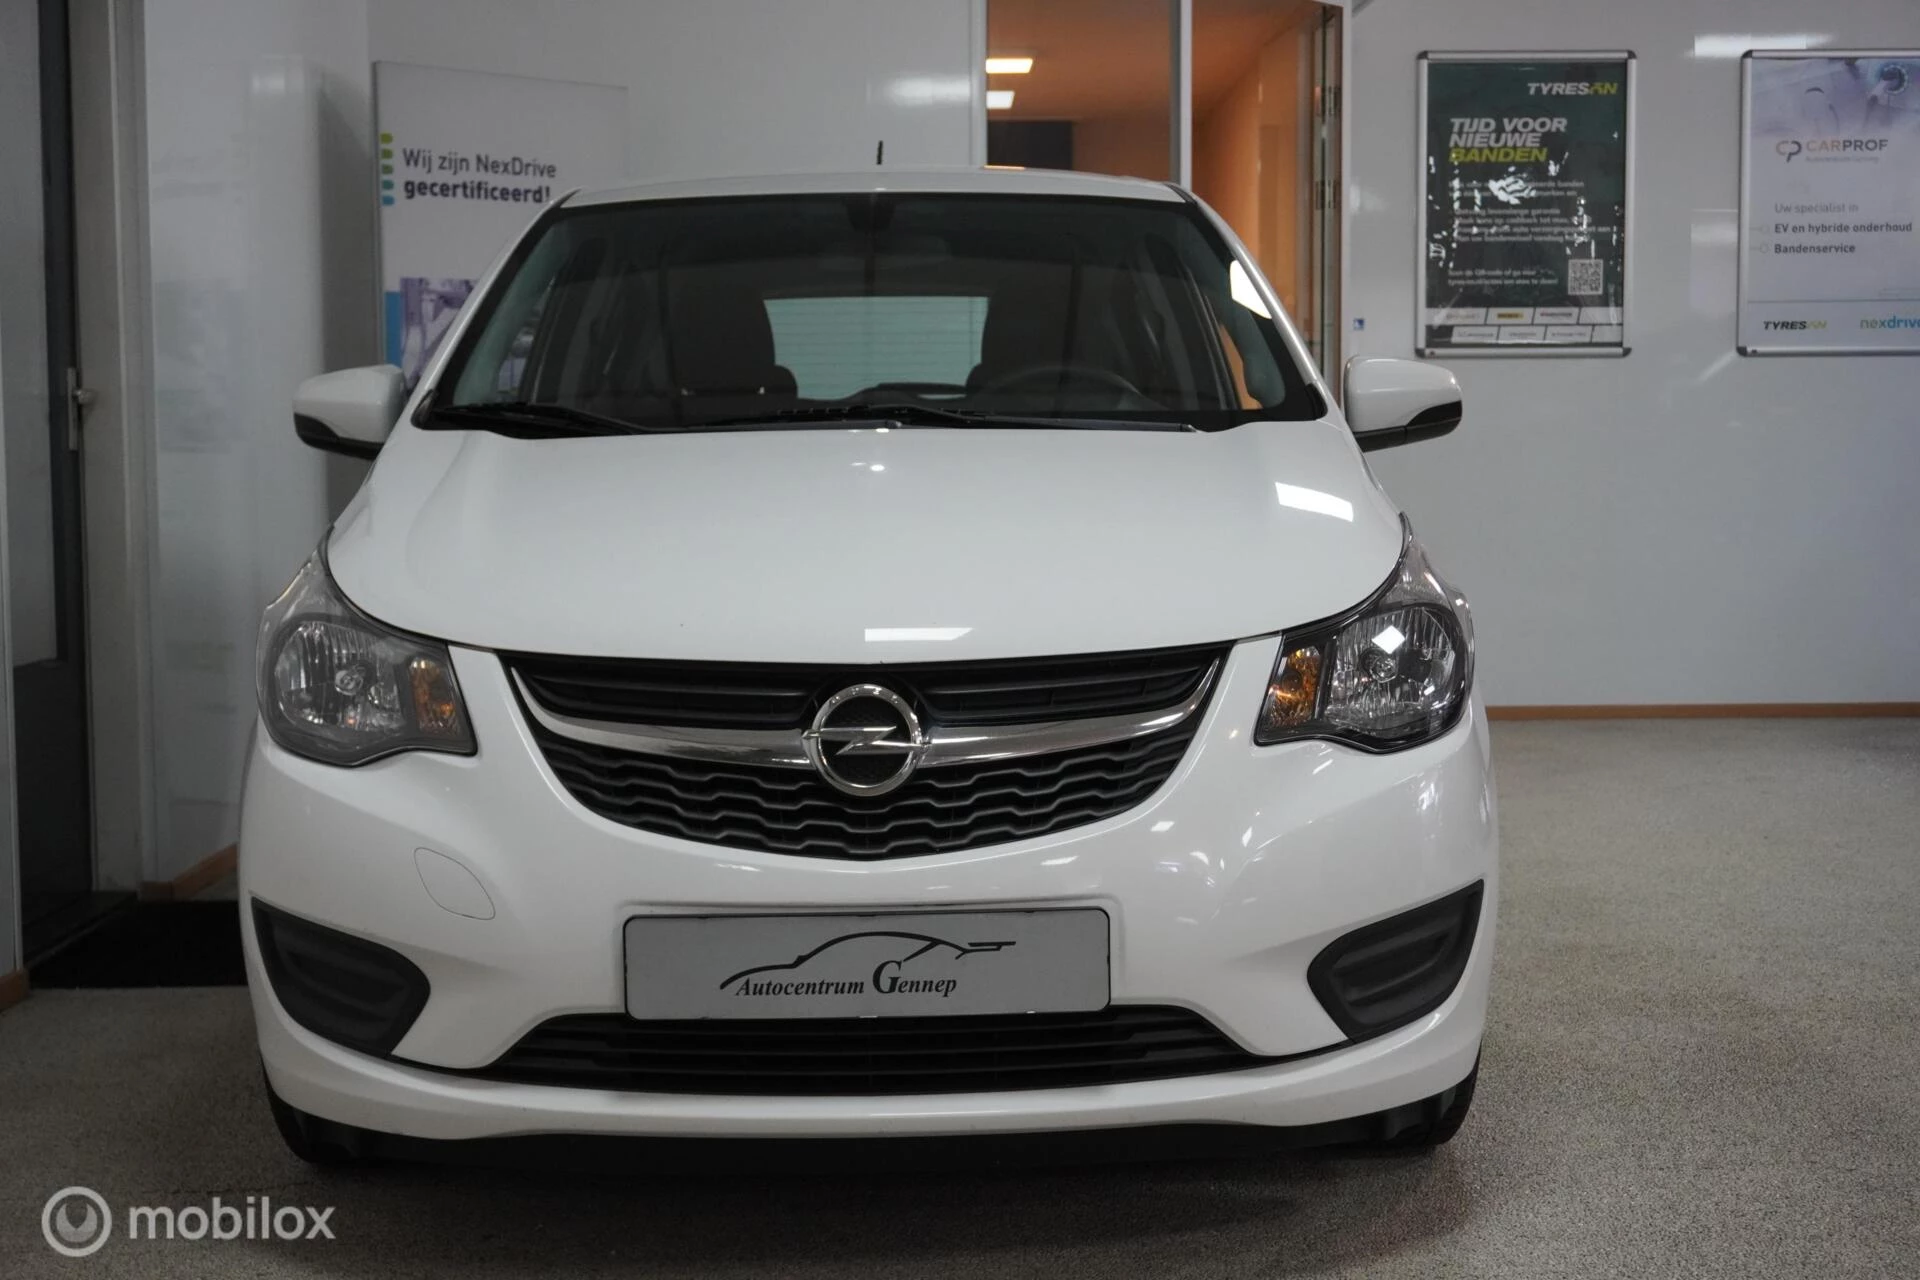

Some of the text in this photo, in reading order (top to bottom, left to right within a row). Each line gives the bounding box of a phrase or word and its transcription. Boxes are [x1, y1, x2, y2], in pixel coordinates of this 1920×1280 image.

[1527, 82, 1618, 95] TYRESAN
[1450, 117, 1568, 133] TIJD VOOR
[1449, 132, 1542, 148] NIEUWE
[1806, 139, 1888, 152] CARPROF
[402, 148, 557, 178] Wij zijn NexDrive
[1449, 147, 1548, 163] BANDEN
[404, 180, 550, 203] gecertificeerd!
[1774, 203, 1859, 216] Uw specialist in
[1774, 222, 1912, 235] EV en hybride onderhoud
[1774, 244, 1856, 254] Bandenservice
[736, 960, 957, 998] Autocentrum Gennep
